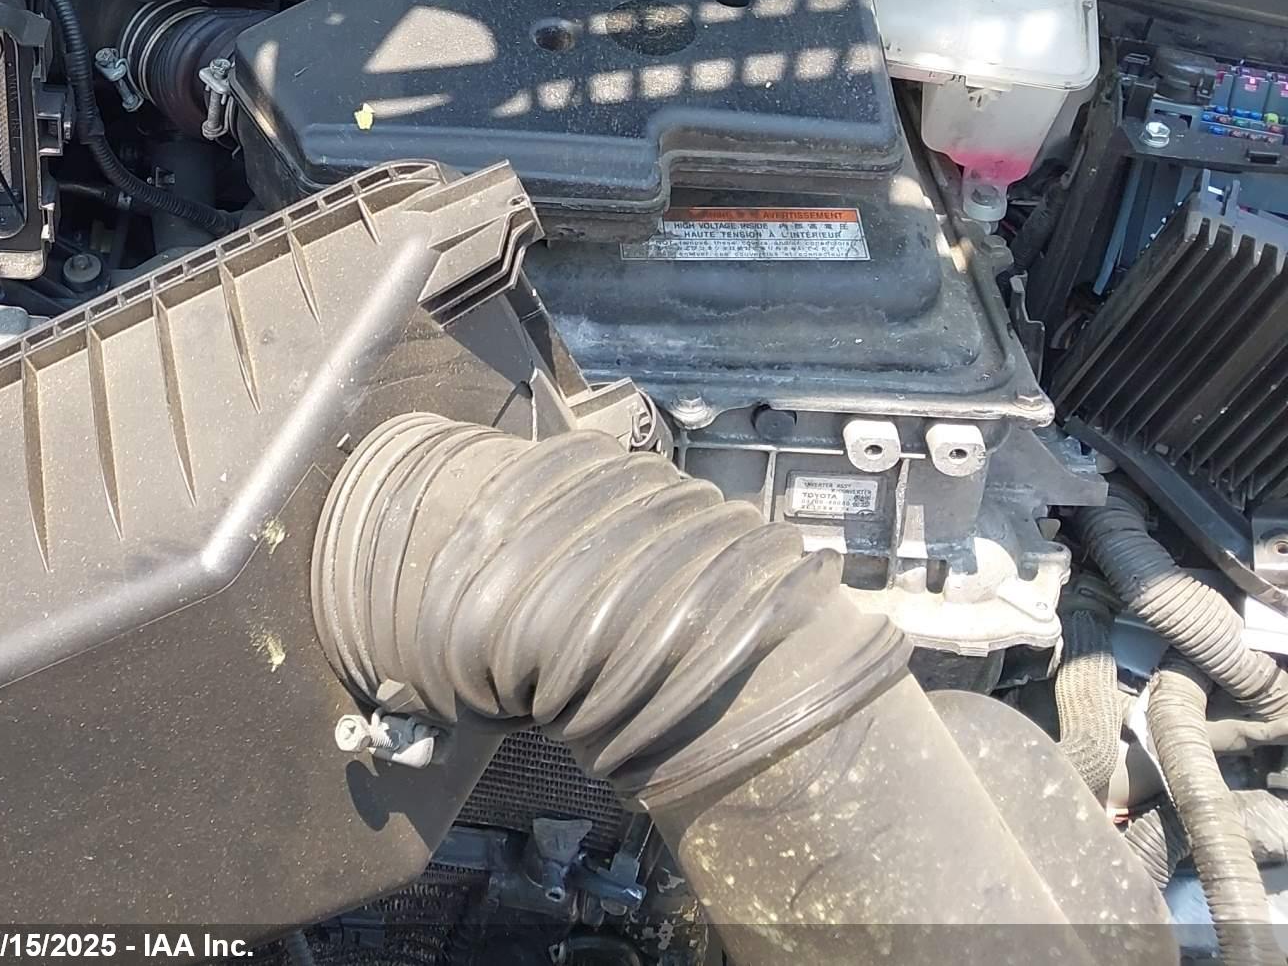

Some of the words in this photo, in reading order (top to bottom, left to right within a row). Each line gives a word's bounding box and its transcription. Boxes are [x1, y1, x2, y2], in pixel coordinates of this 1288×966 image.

[762, 211, 844, 220] AVERTISSEMENT
[673, 222, 695, 230] HIGH
[699, 222, 736, 230] VOLTAGE
[740, 222, 768, 230] INSIDE
